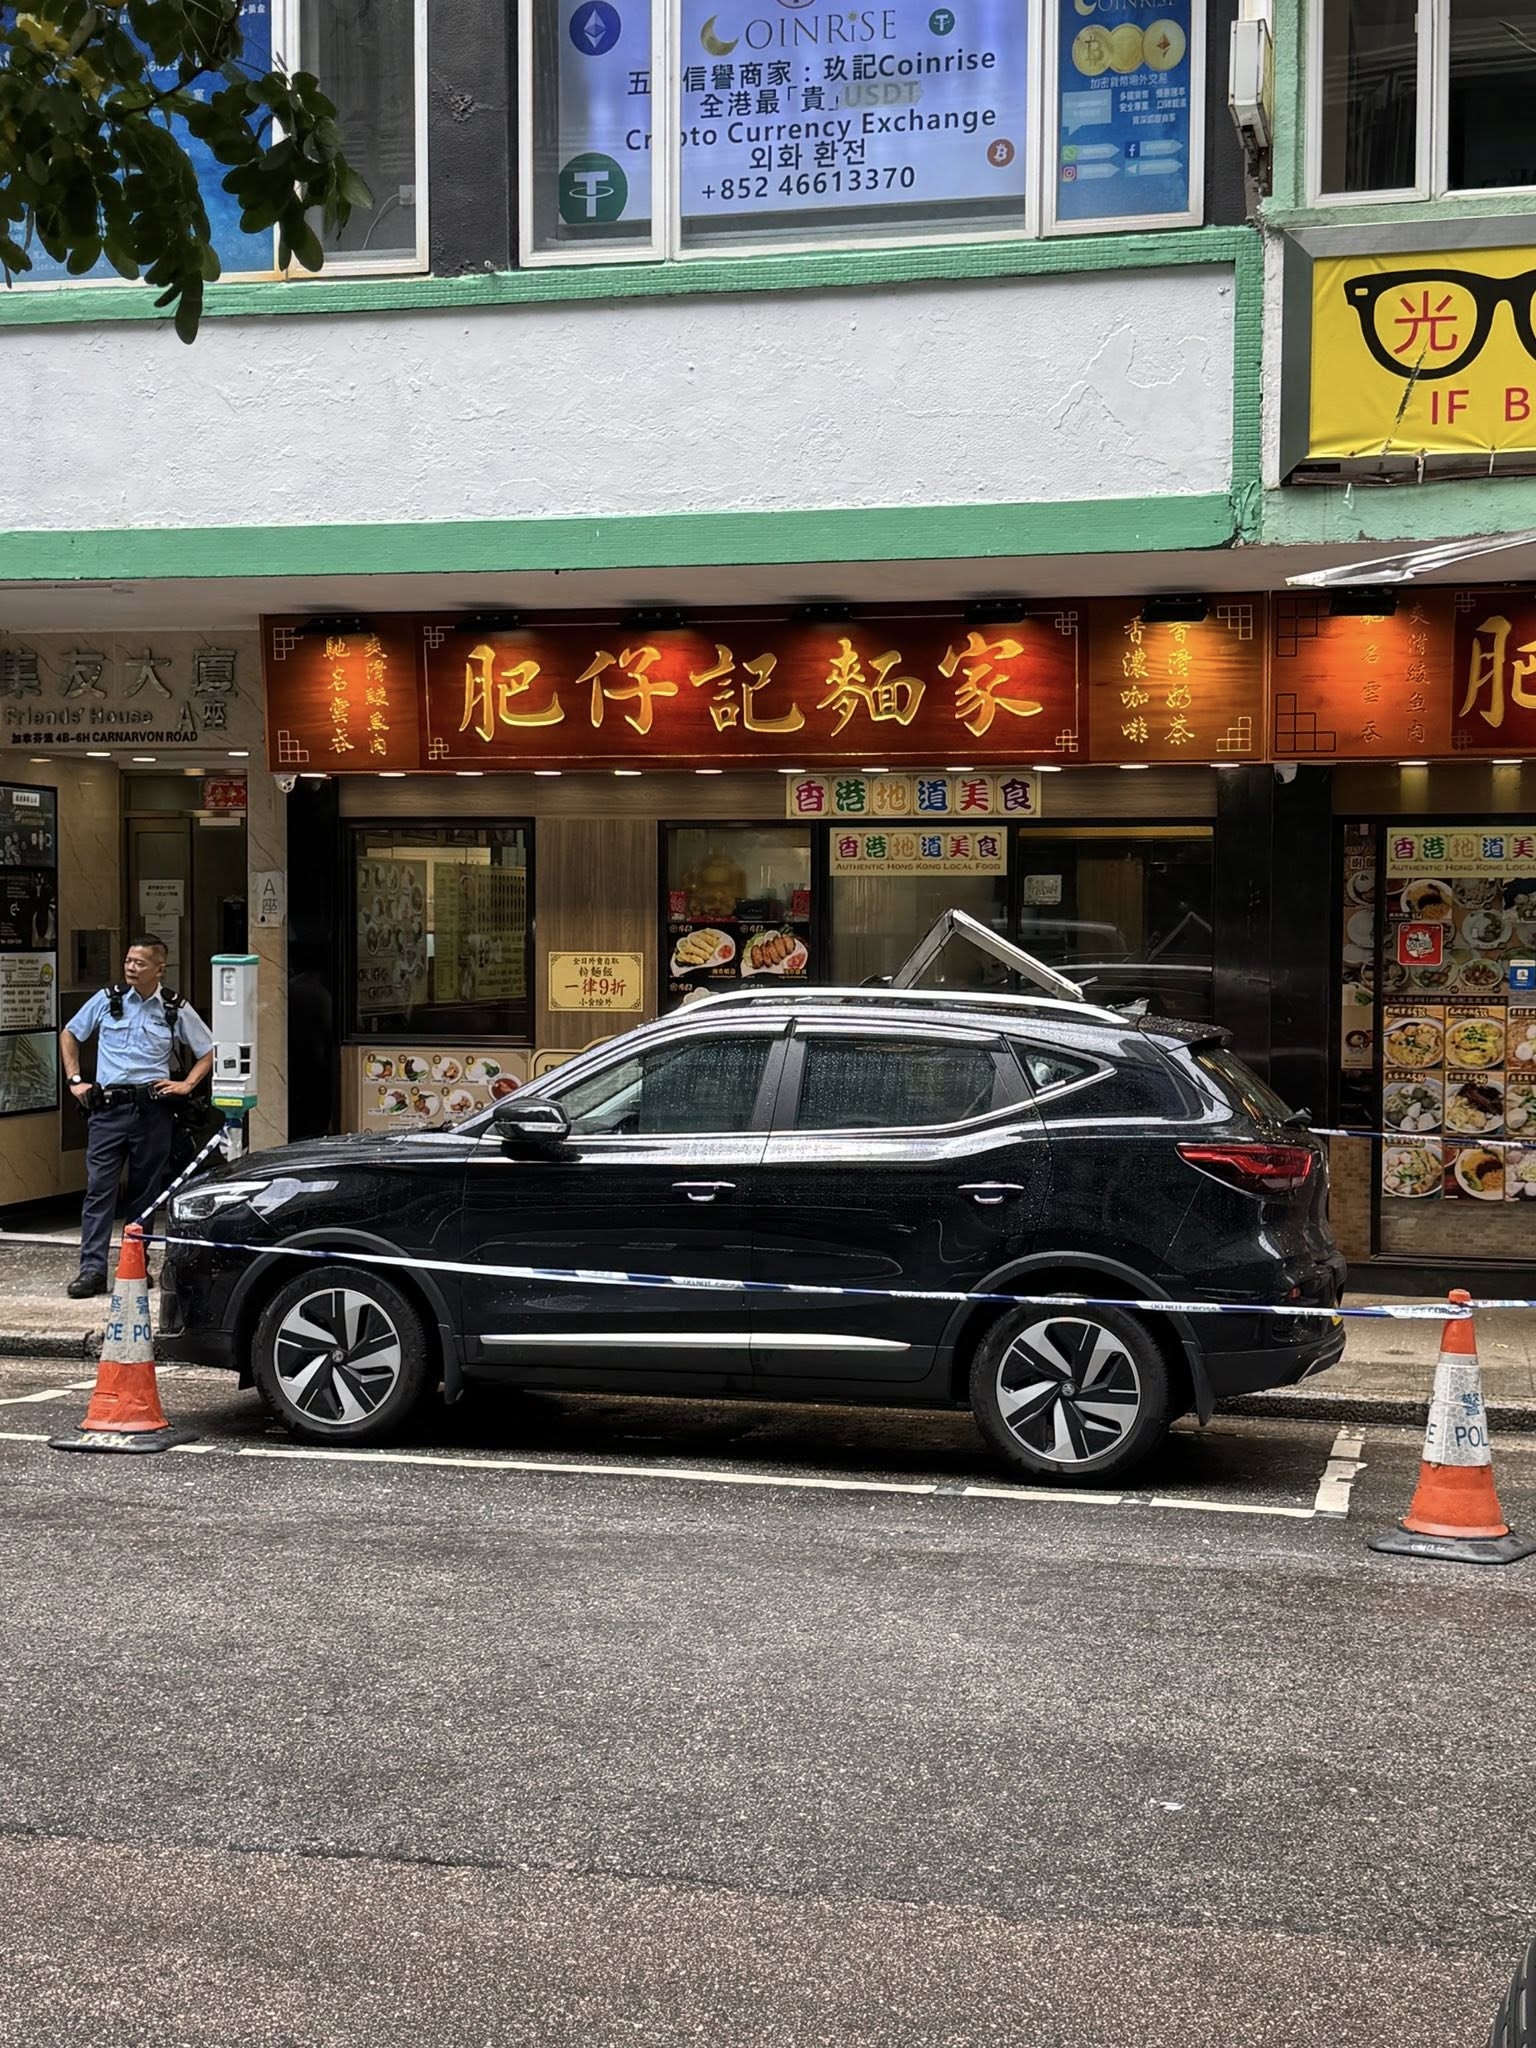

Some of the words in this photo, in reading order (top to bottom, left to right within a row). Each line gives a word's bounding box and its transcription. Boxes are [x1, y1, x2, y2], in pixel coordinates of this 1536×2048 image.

[844, 81, 919, 108] USDT
[728, 117, 851, 143] Currency
[862, 109, 996, 134] Exchange
[750, 143, 802, 172] 외화
[814, 138, 865, 169] 환전
[702, 176, 768, 200] +852
[778, 166, 915, 196] 46613370
[1393, 290, 1458, 354] 光
[1431, 389, 1470, 425] IF
[459, 632, 1043, 742] 肥仔記麵家
[1120, 616, 1149, 743] 香濃咖啡
[323, 637, 354, 753] 馳名雲吞
[89, 706, 153, 725] House
[92, 731, 164, 743] CARNARVON
[166, 731, 198, 743] ROAD
[795, 778, 1032, 812] 香港地道美食
[838, 835, 998, 858] 香港地道美食
[1394, 836, 1534, 859] 香港地道美
[836, 863, 884, 871] AUTHENTIC
[887, 863, 913, 871] HONG
[915, 863, 941, 871] KONG
[943, 863, 973, 871] LOCAL
[976, 863, 1000, 871] FOOD
[1391, 863, 1441, 872] AUTHENTIC
[1446, 863, 1473, 872] HONG
[1476, 863, 1502, 872] KONG
[565, 977, 627, 997] 一律9折
[579, 966, 613, 978] 粉麵飯
